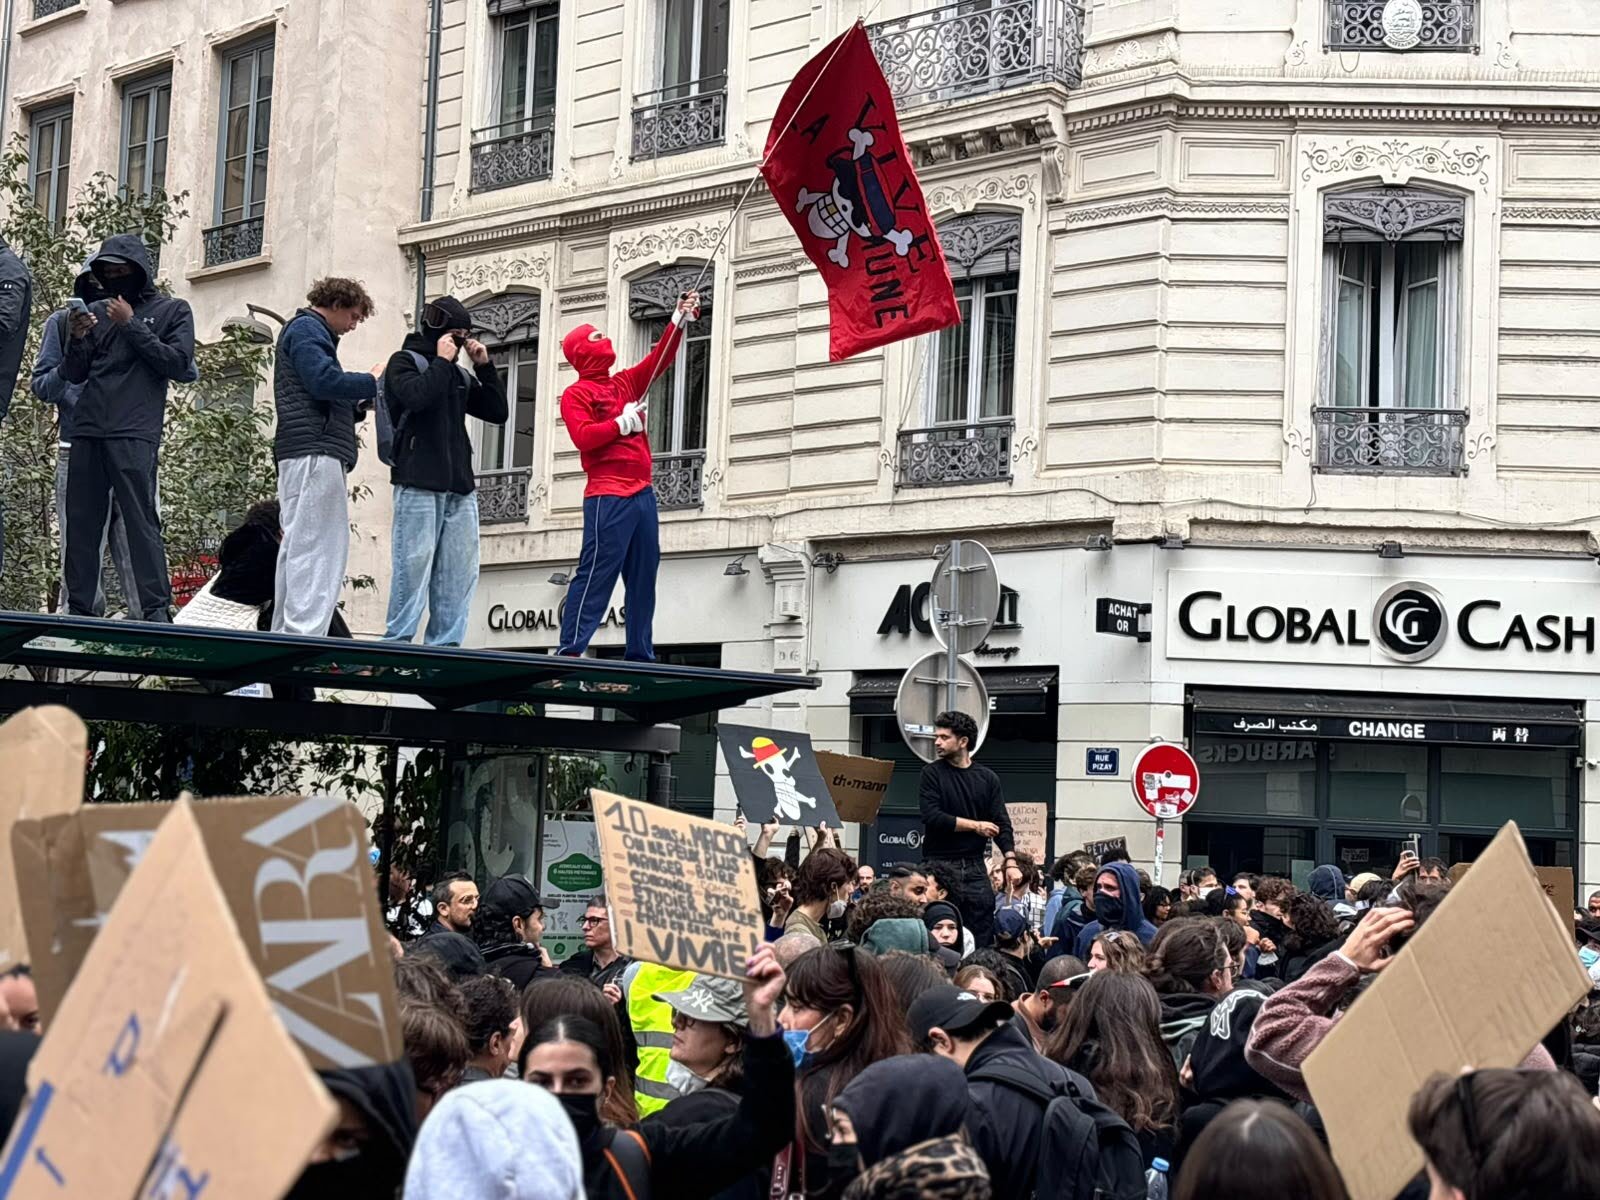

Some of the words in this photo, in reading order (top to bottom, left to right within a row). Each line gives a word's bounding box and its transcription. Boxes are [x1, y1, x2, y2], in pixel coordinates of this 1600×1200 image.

[488, 604, 558, 632] GLOBAL
[1108, 602, 1138, 619] ACHAT
[1116, 619, 1129, 633] OR
[1178, 590, 1370, 646] GLOBAL
[1457, 600, 1597, 653] CASH
[1233, 716, 1275, 732] الصرف
[1278, 718, 1318, 732] مكتب
[1348, 720, 1426, 739] CHANGE
[1095, 754, 1110, 762] RUE
[1092, 763, 1113, 771] PIZAY
[604, 801, 649, 837] 10
[879, 833, 906, 845] GLOBAL
[626, 851, 685, 877] MANGER
[695, 863, 737, 887] BOIRE
[646, 926, 747, 977] VIVRE
